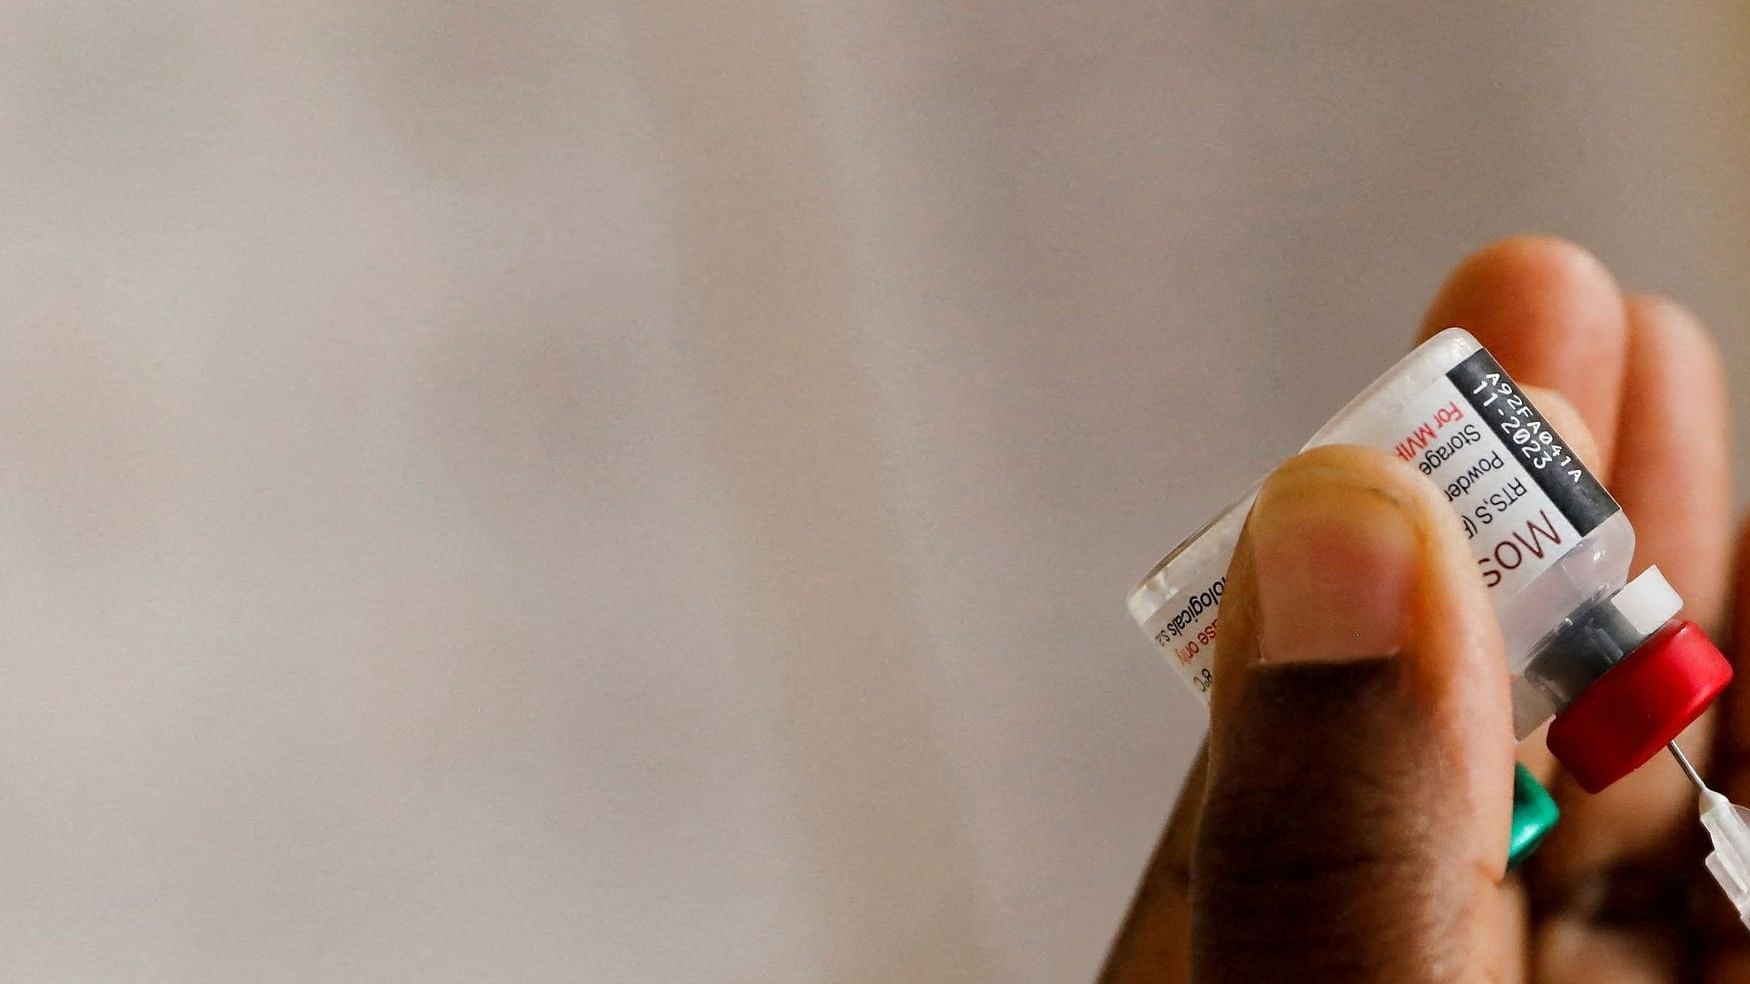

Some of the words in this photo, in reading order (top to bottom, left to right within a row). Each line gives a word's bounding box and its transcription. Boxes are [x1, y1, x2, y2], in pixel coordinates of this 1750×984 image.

[1433, 402, 1465, 430] For
[1473, 381, 1553, 469] 11-2023
[1418, 423, 1481, 476] Storage
[1444, 450, 1505, 502] Powder
[1475, 477, 1528, 525] RTS,S
